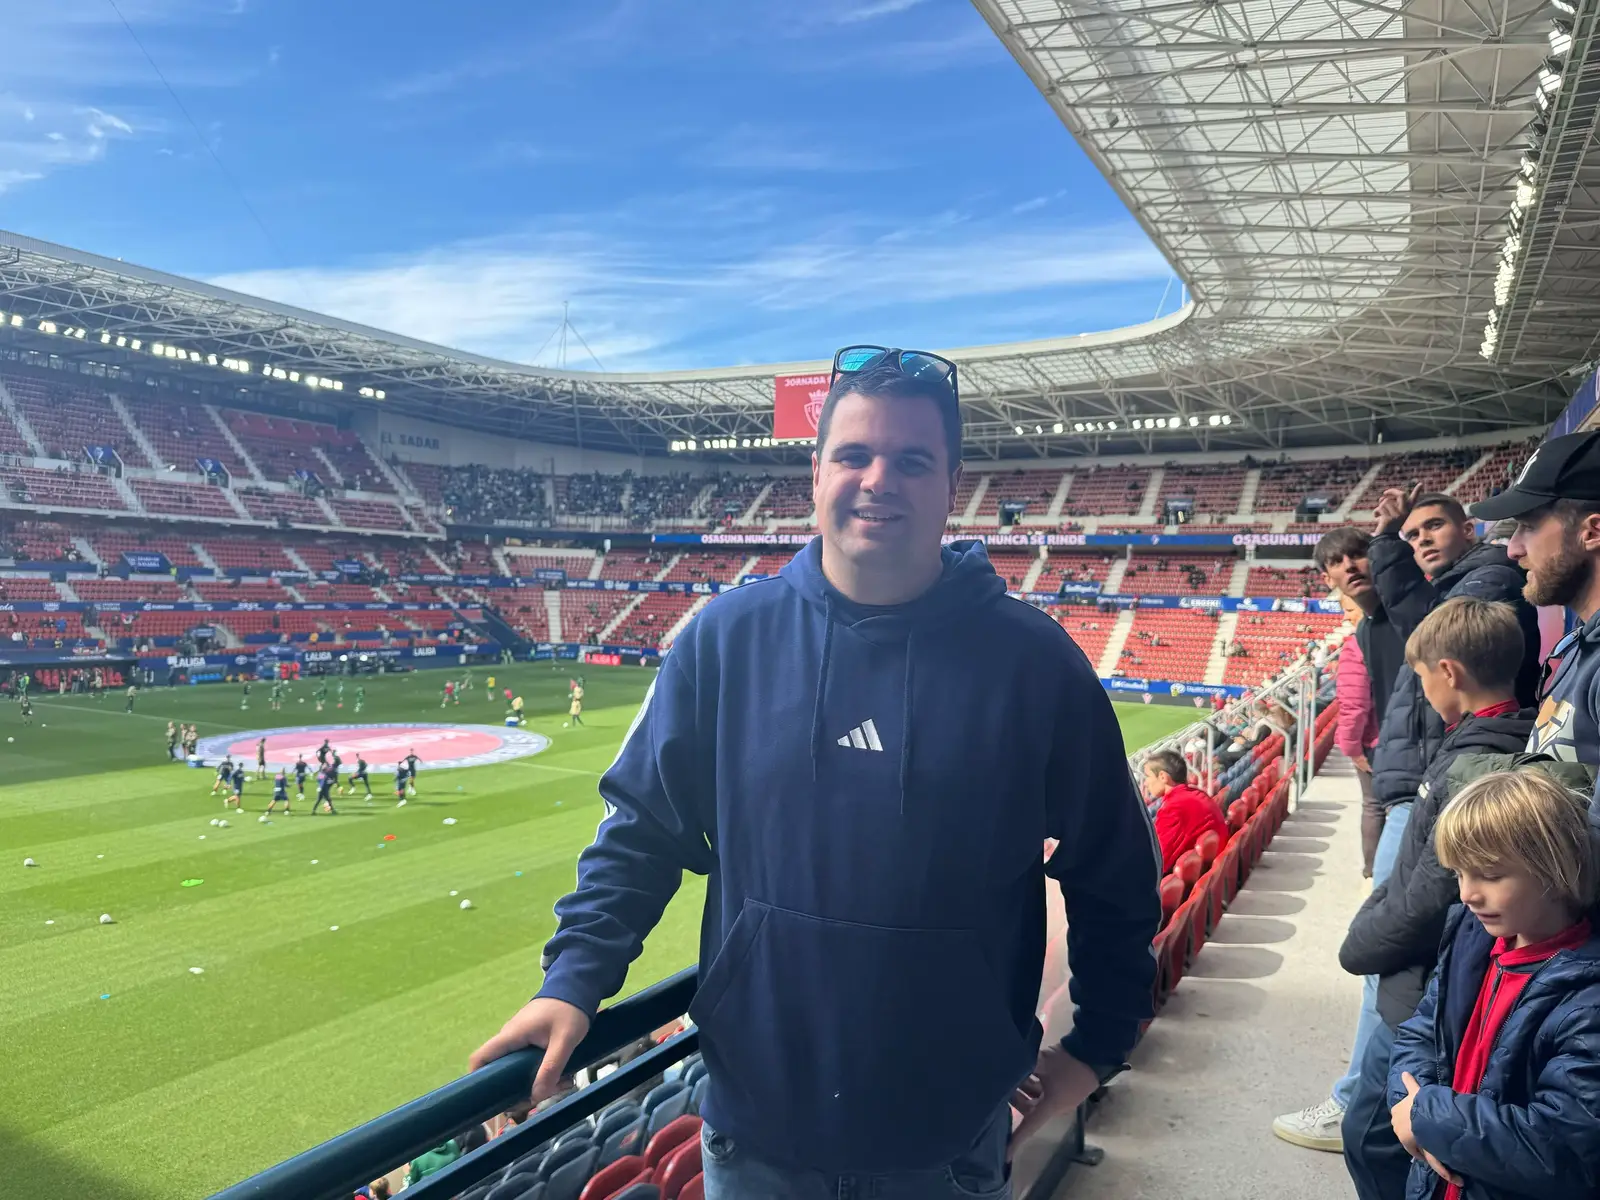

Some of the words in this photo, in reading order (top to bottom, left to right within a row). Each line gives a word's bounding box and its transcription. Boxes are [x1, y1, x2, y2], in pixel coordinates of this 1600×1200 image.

[785, 377, 826, 387] JORNADA
[381, 431, 394, 445] EL
[400, 434, 440, 450] SADAR
[701, 534, 744, 544] OSASUNA
[744, 534, 777, 544] NUNCA
[778, 534, 790, 544] SE
[791, 534, 815, 544] RIN
[987, 534, 1028, 546] NUNCA
[1030, 534, 1045, 546] SE
[1047, 534, 1086, 546] RINDE
[1232, 534, 1300, 546] OSASUNA
[305, 651, 332, 662] LALIGA
[413, 646, 436, 657] LALIGA
[174, 656, 206, 668] LALIGA
